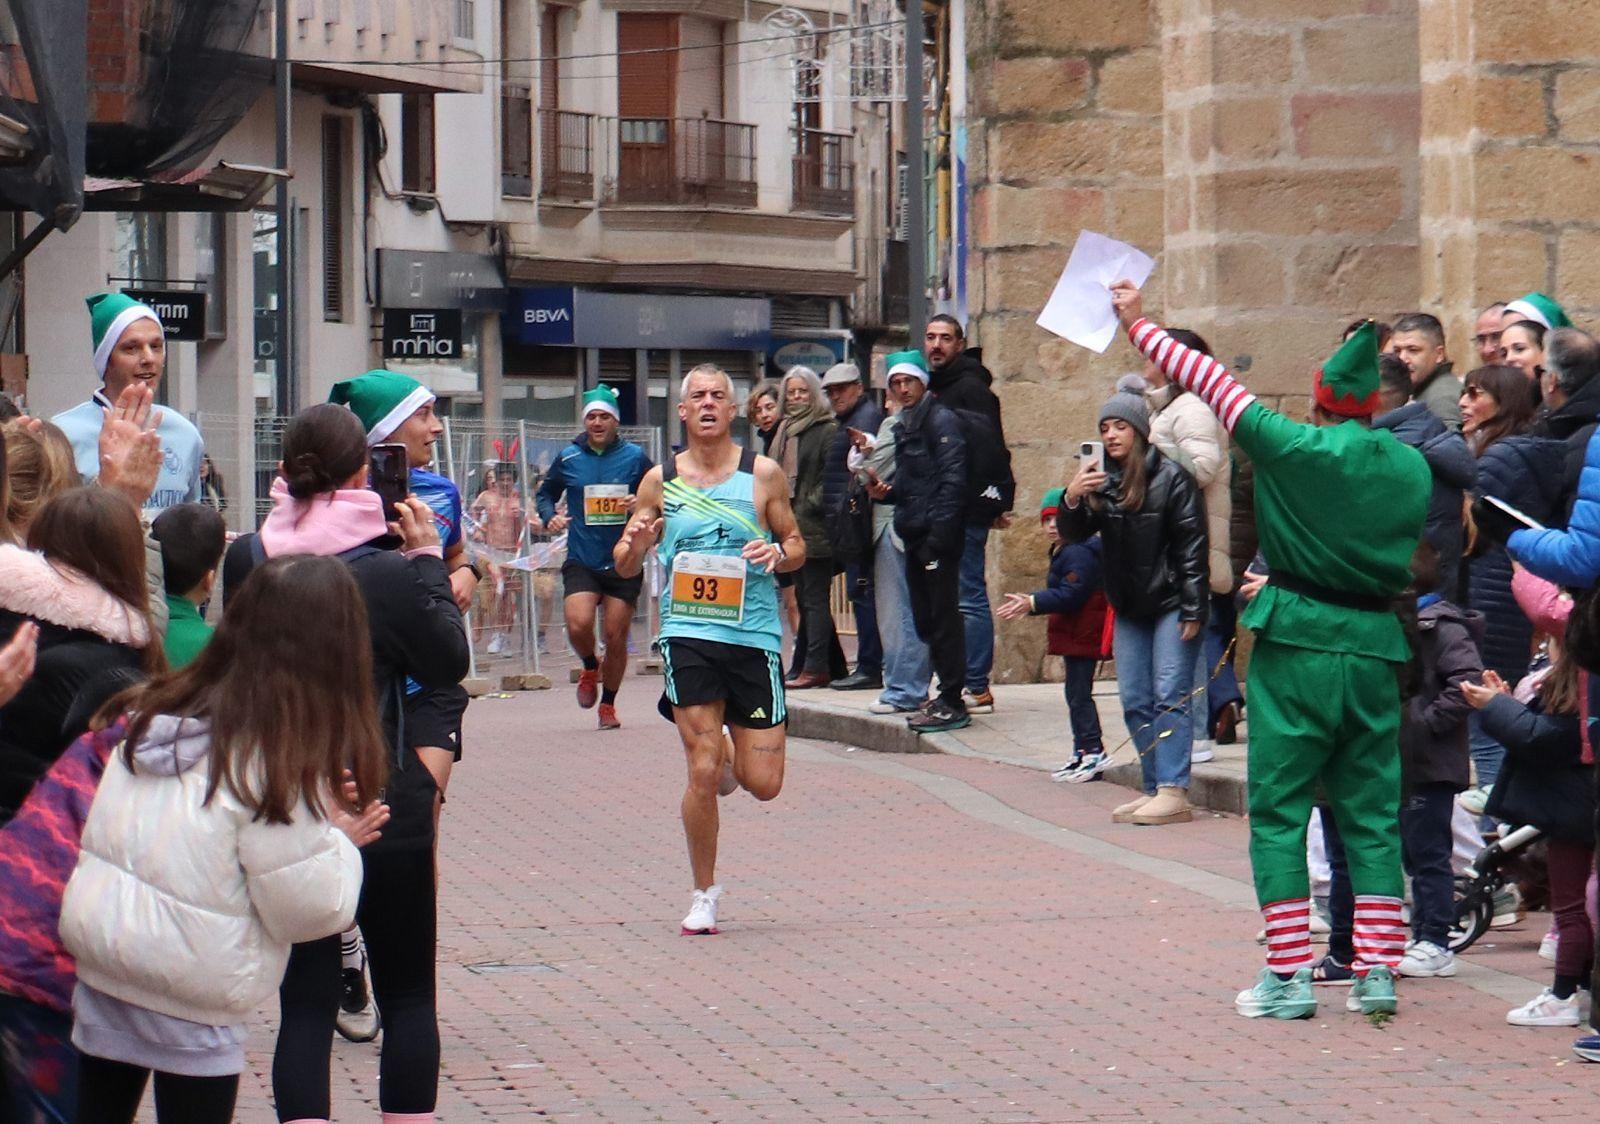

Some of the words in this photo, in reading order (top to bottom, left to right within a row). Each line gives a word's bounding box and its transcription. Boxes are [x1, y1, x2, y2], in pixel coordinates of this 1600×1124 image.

[138, 298, 189, 319] imm
[524, 308, 569, 323] BBVA
[392, 335, 453, 356] mhia
[596, 498, 618, 512] 187
[693, 577, 718, 601] 93
